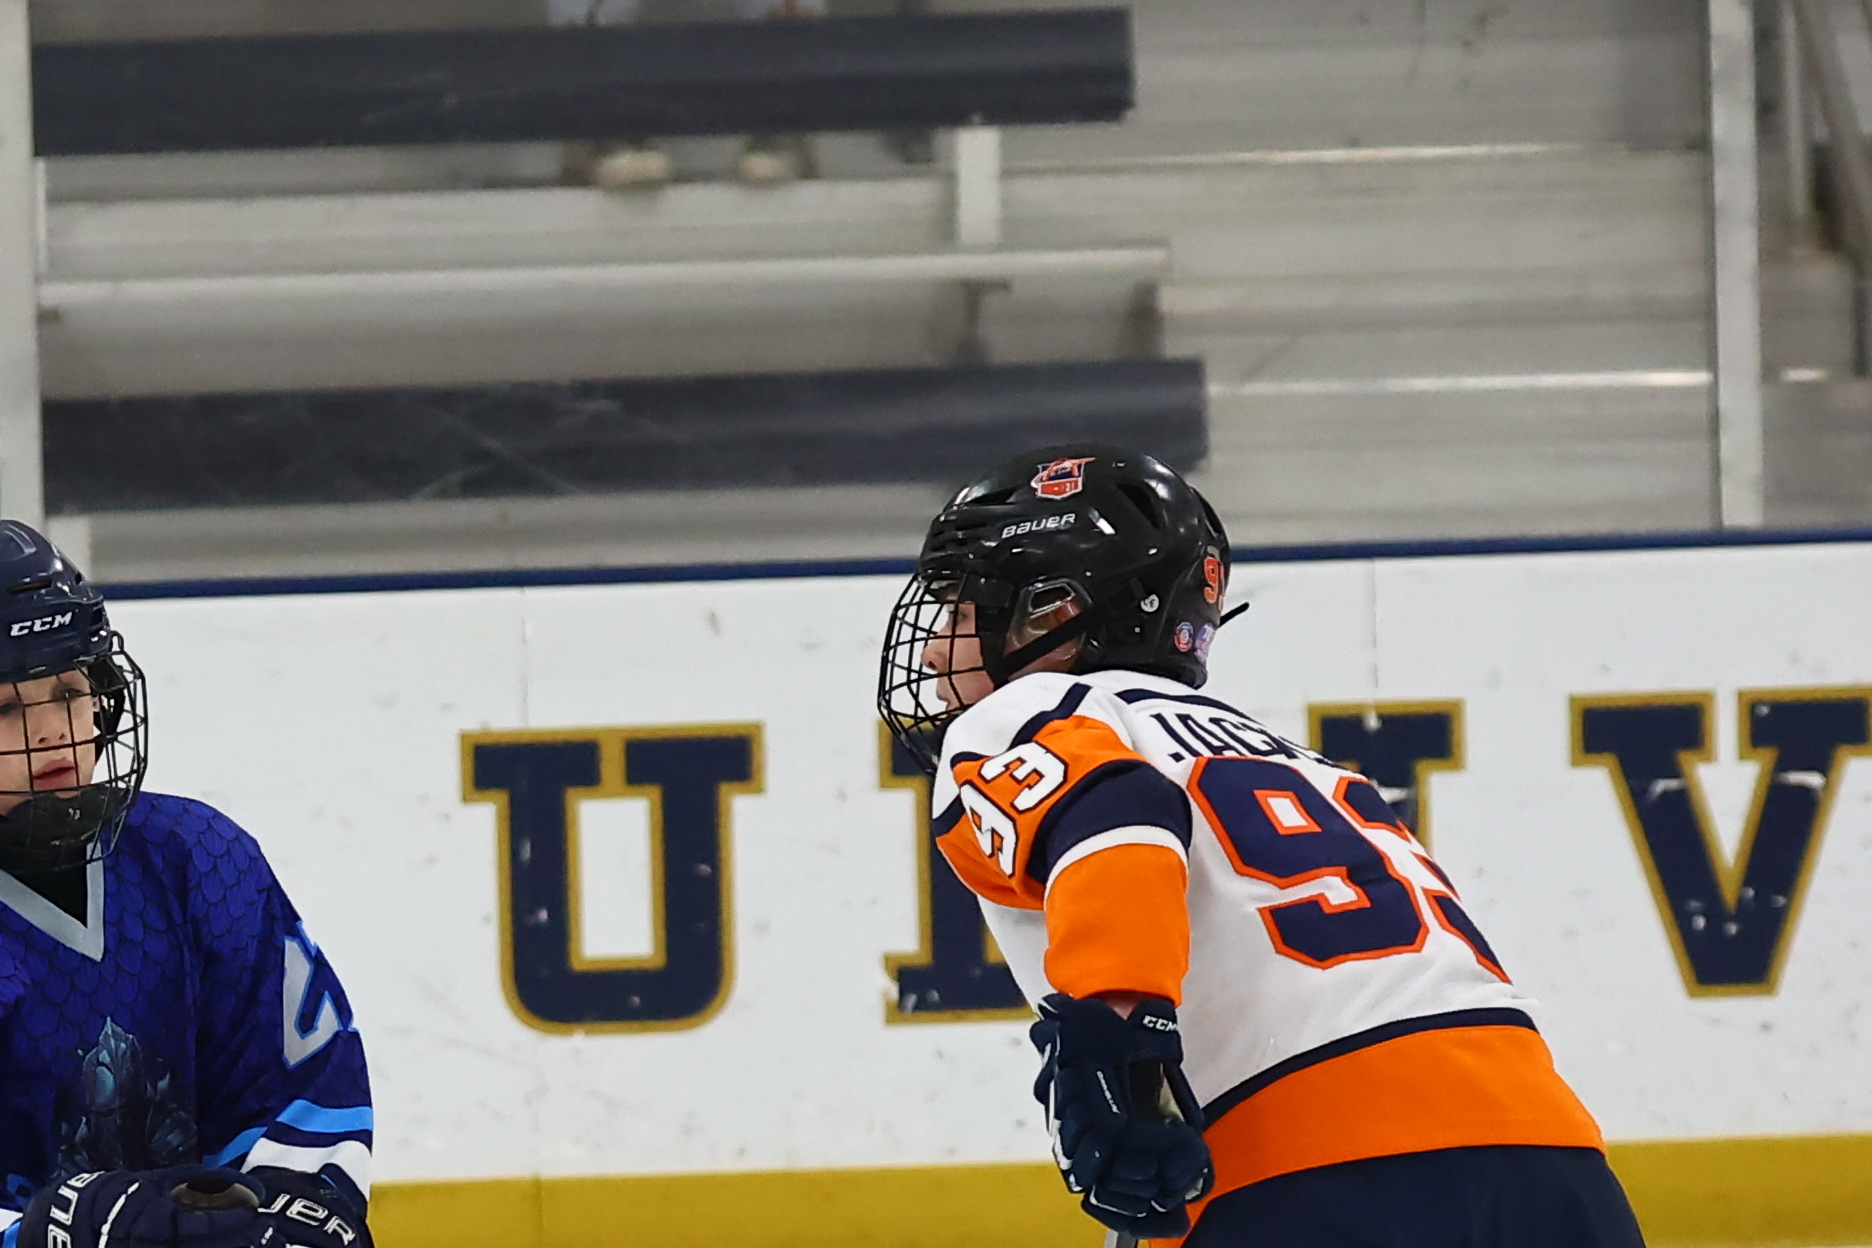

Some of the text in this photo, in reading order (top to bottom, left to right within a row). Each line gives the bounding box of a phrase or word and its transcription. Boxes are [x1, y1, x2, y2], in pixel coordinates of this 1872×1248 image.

[1001, 512, 1076, 539] BAUER
[10, 611, 73, 637] CCM
[959, 739, 1071, 880] 93
[1142, 1014, 1178, 1032] CCM
